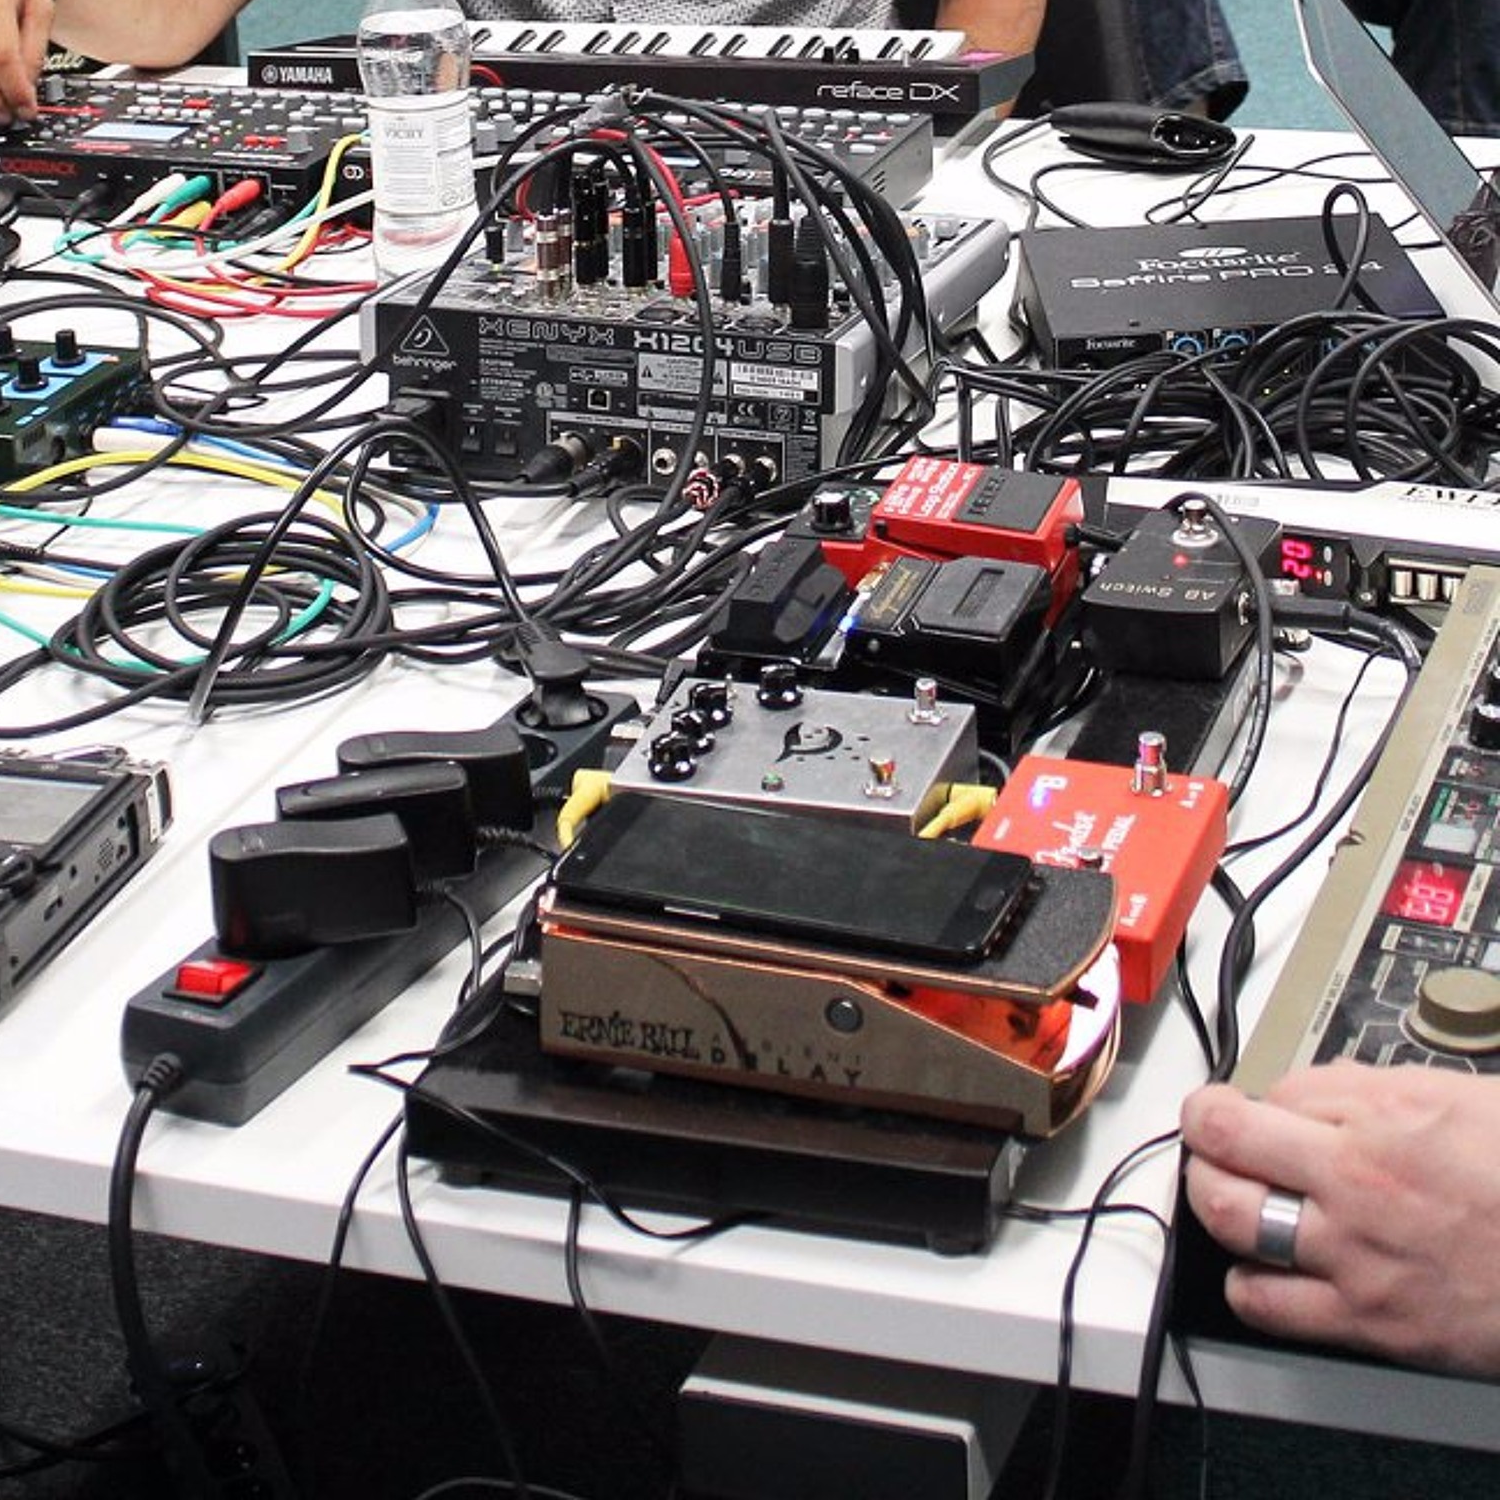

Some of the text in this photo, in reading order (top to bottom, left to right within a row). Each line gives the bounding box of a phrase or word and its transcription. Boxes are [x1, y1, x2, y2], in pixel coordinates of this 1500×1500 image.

[279, 66, 333, 84] YAMAHA
[816, 80, 960, 101] reface DX
[1136, 251, 1300, 272] Focusrite
[1071, 272, 1212, 288] Saffire
[1219, 264, 1314, 280] PRO
[478, 316, 615, 347] XENYX
[392, 353, 458, 374] behringer
[1099, 581, 1174, 599] Switch
[560, 1010, 634, 1048] ERNIE
